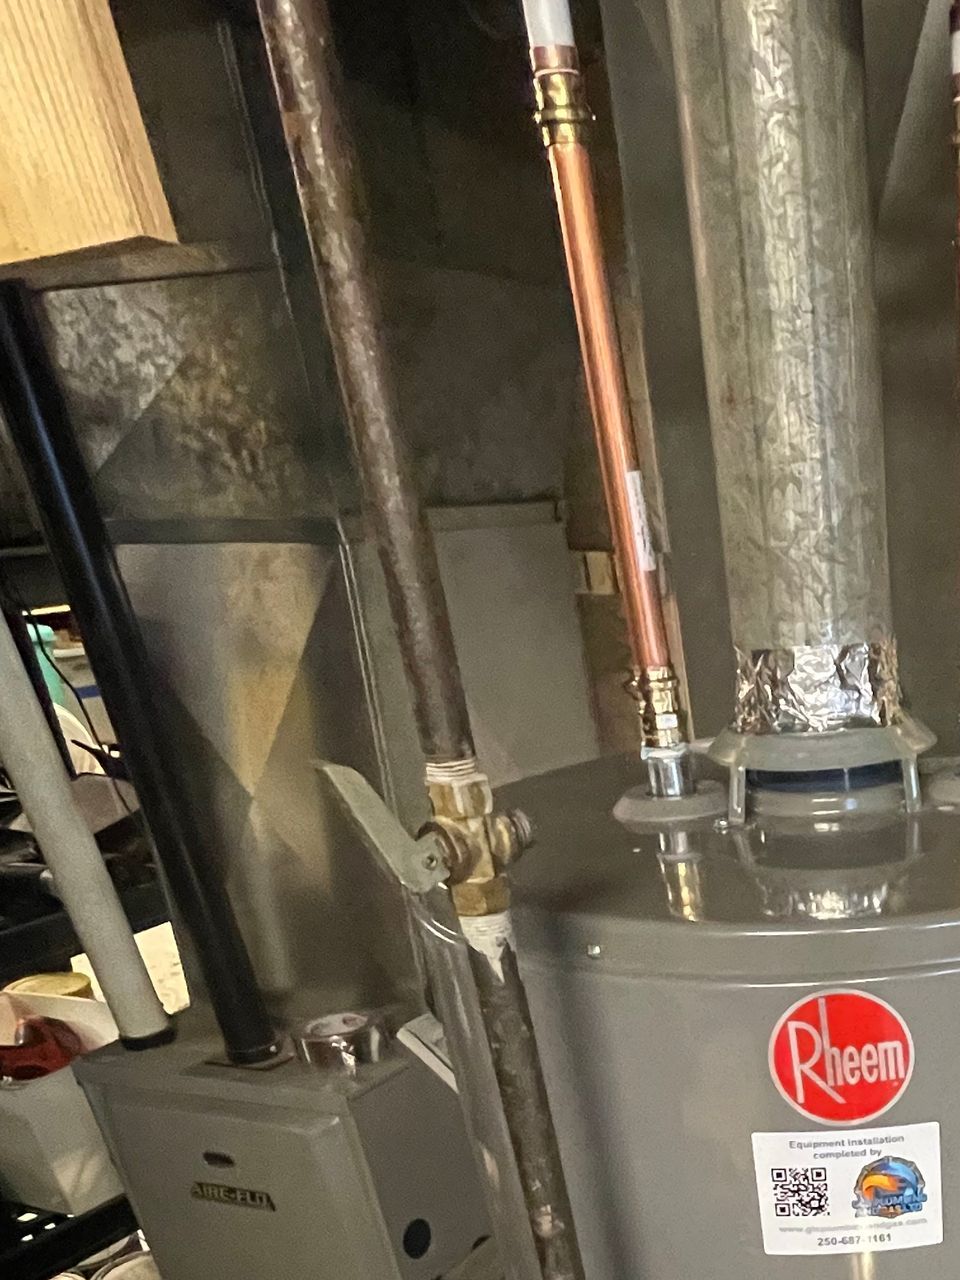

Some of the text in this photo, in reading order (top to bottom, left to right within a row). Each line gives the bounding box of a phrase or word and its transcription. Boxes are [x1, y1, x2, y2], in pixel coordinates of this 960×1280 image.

[787, 997, 906, 1105] Rheem
[788, 1139, 845, 1150] Equipment
[813, 1148, 882, 1160] completed by
